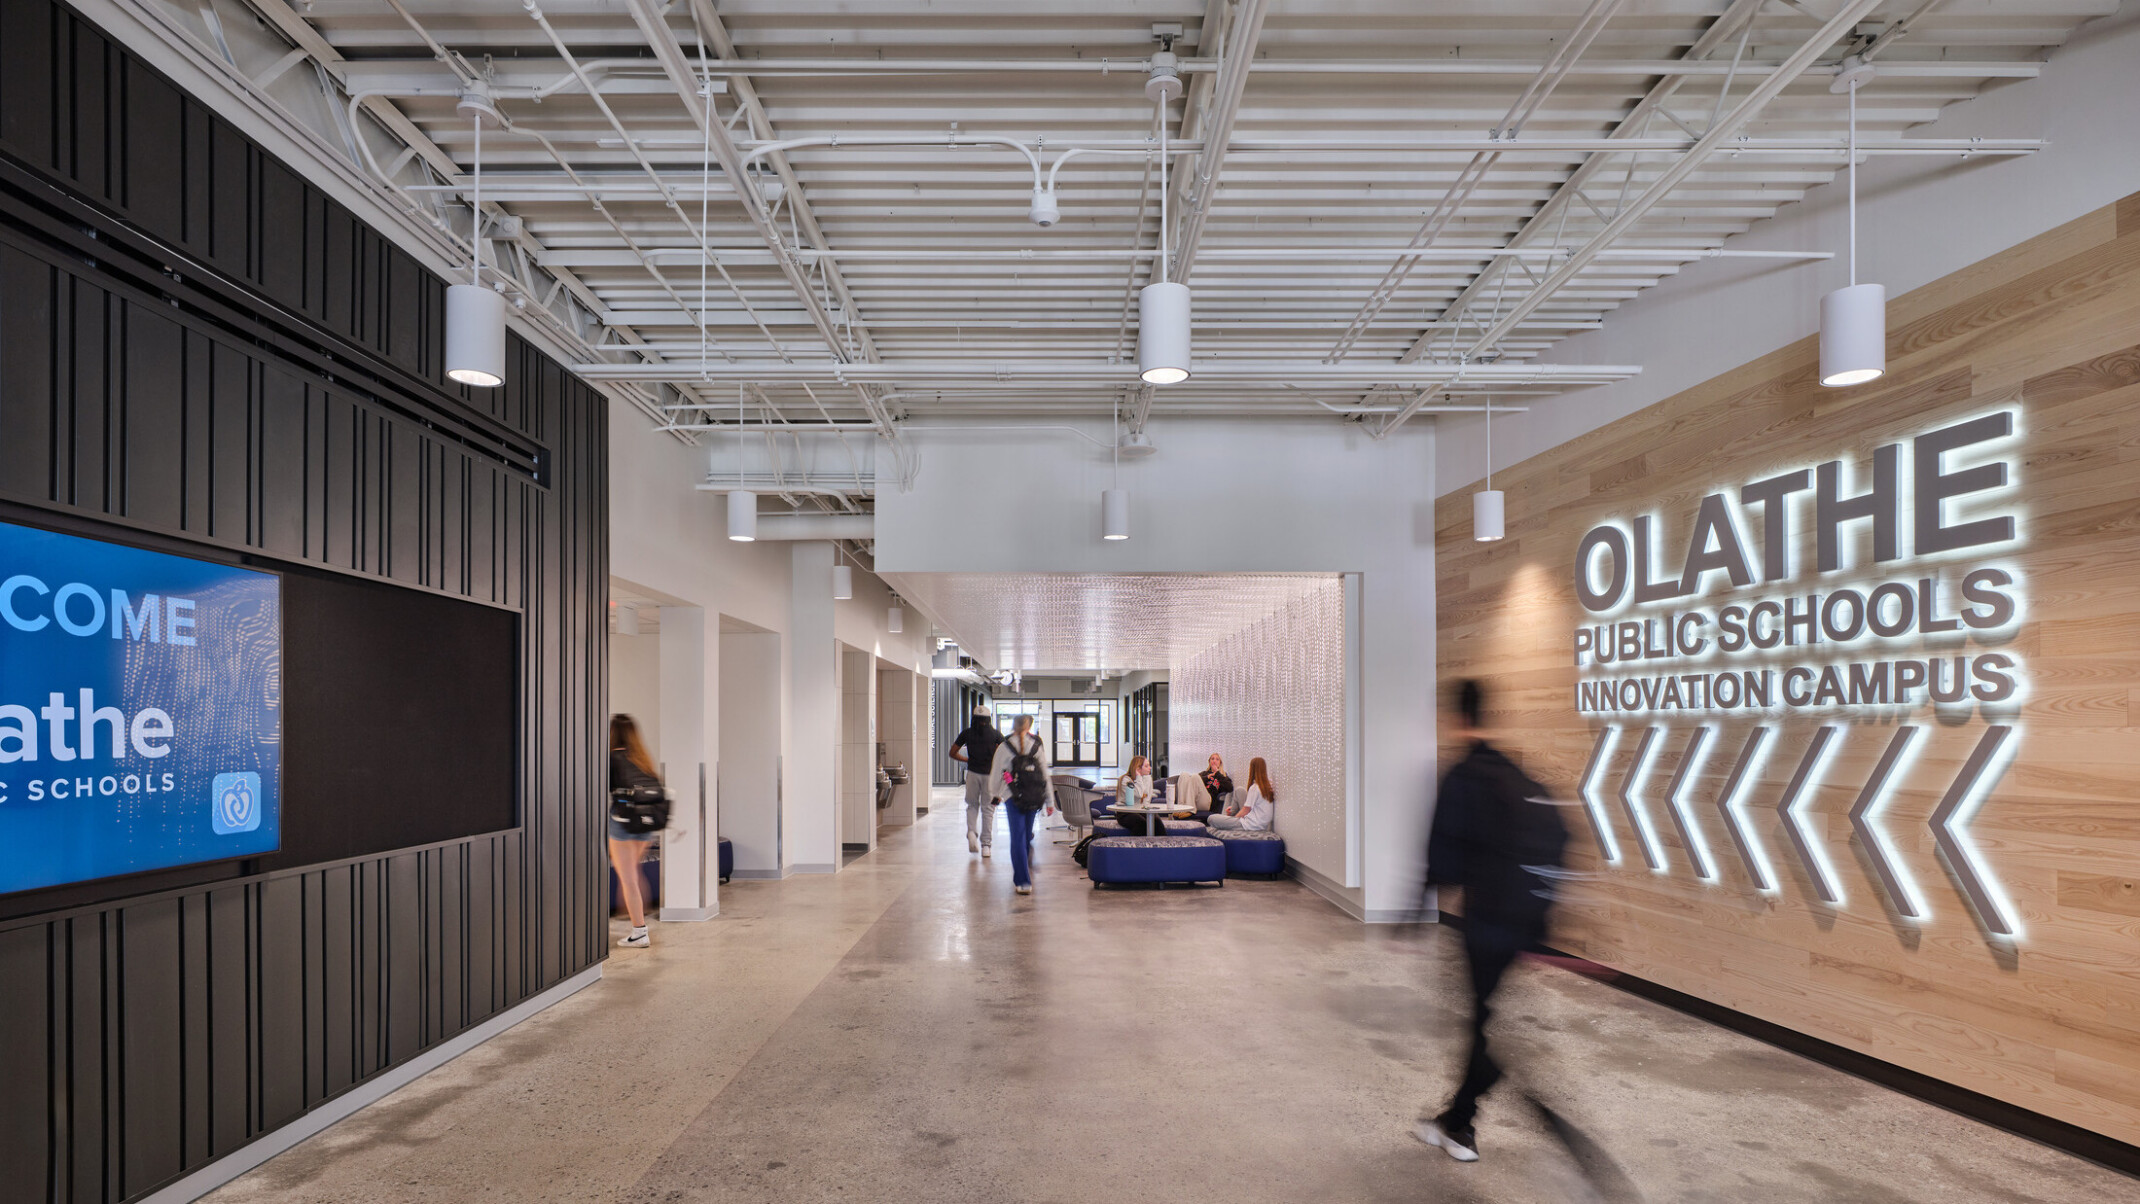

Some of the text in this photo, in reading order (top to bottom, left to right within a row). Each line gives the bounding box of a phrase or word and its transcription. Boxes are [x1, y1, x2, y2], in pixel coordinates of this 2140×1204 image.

[1575, 411, 2015, 611] OLATHE
[0, 575, 196, 647] COME
[1574, 568, 2015, 666] PUBLIC SCHOOLS
[1574, 653, 2016, 712] INNOVATION CAMPUS
[28, 772, 175, 801] SCHOOLS
